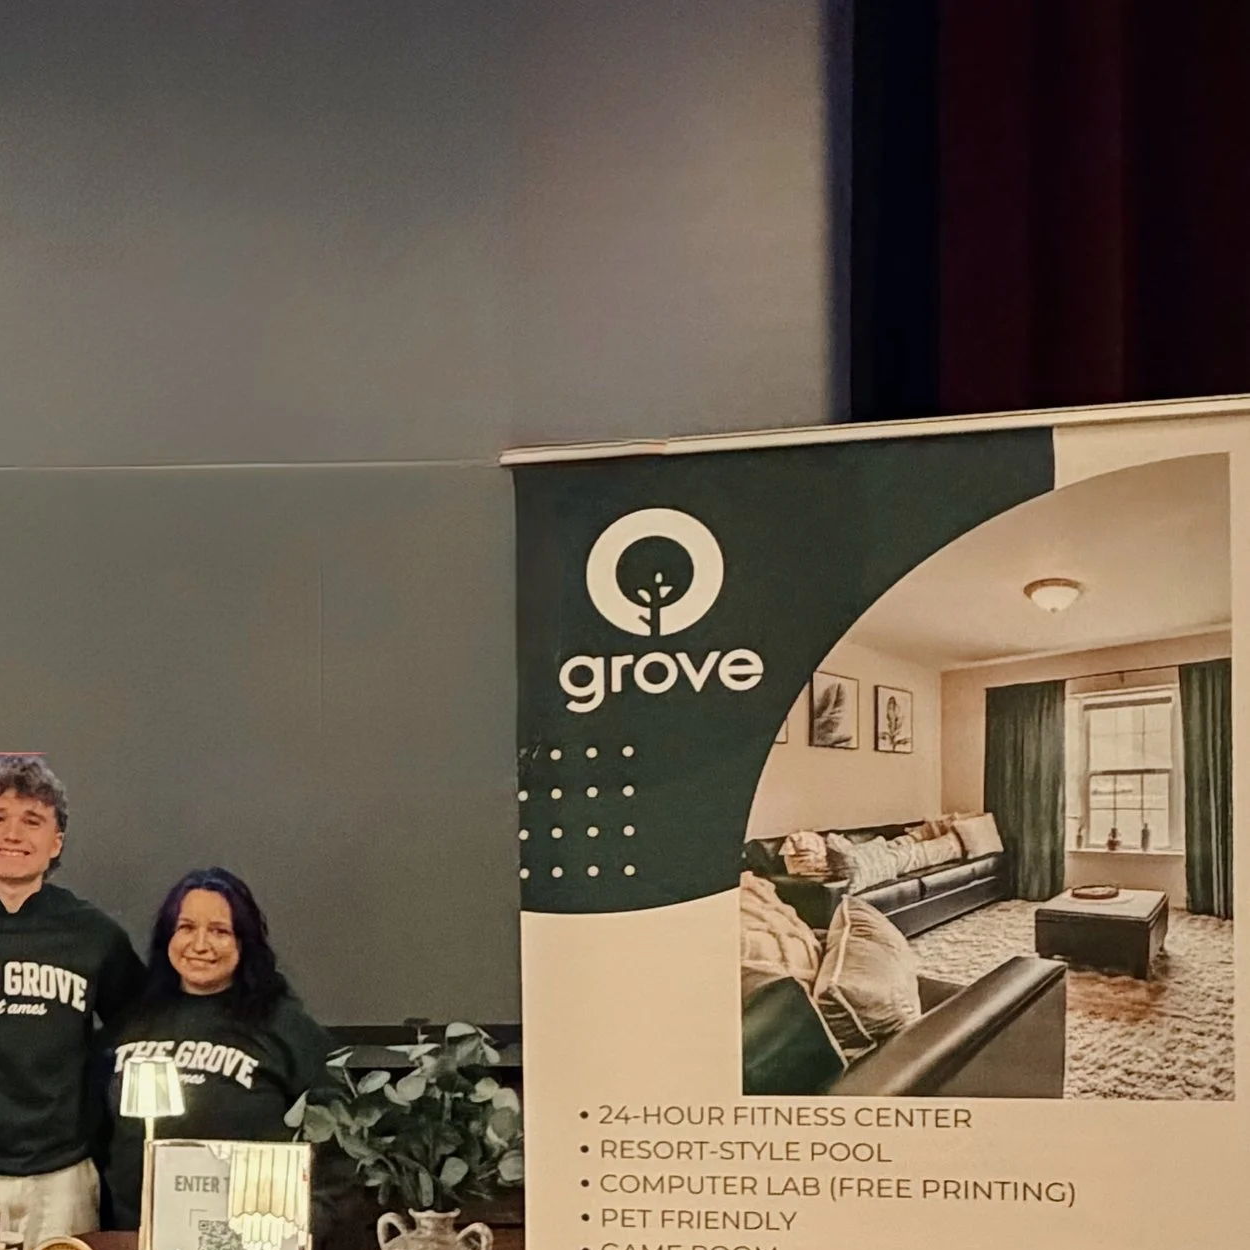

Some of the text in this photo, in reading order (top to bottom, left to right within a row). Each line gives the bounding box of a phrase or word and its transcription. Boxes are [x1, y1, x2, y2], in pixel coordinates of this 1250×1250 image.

[559, 648, 765, 713] grove
[4, 961, 88, 1013] GROVE
[6, 1002, 48, 1016] ames
[174, 1041, 259, 1090] GROVE
[599, 1105, 971, 1128] 24-HOUR FITNESS CENTER
[601, 1140, 892, 1162] RESORT-STYLE POOL
[174, 1175, 220, 1194] ENTER
[600, 1174, 1075, 1208] COMPUTER LAB (FREE PRINTING)
[602, 1209, 797, 1230] PET FRIENDLY
